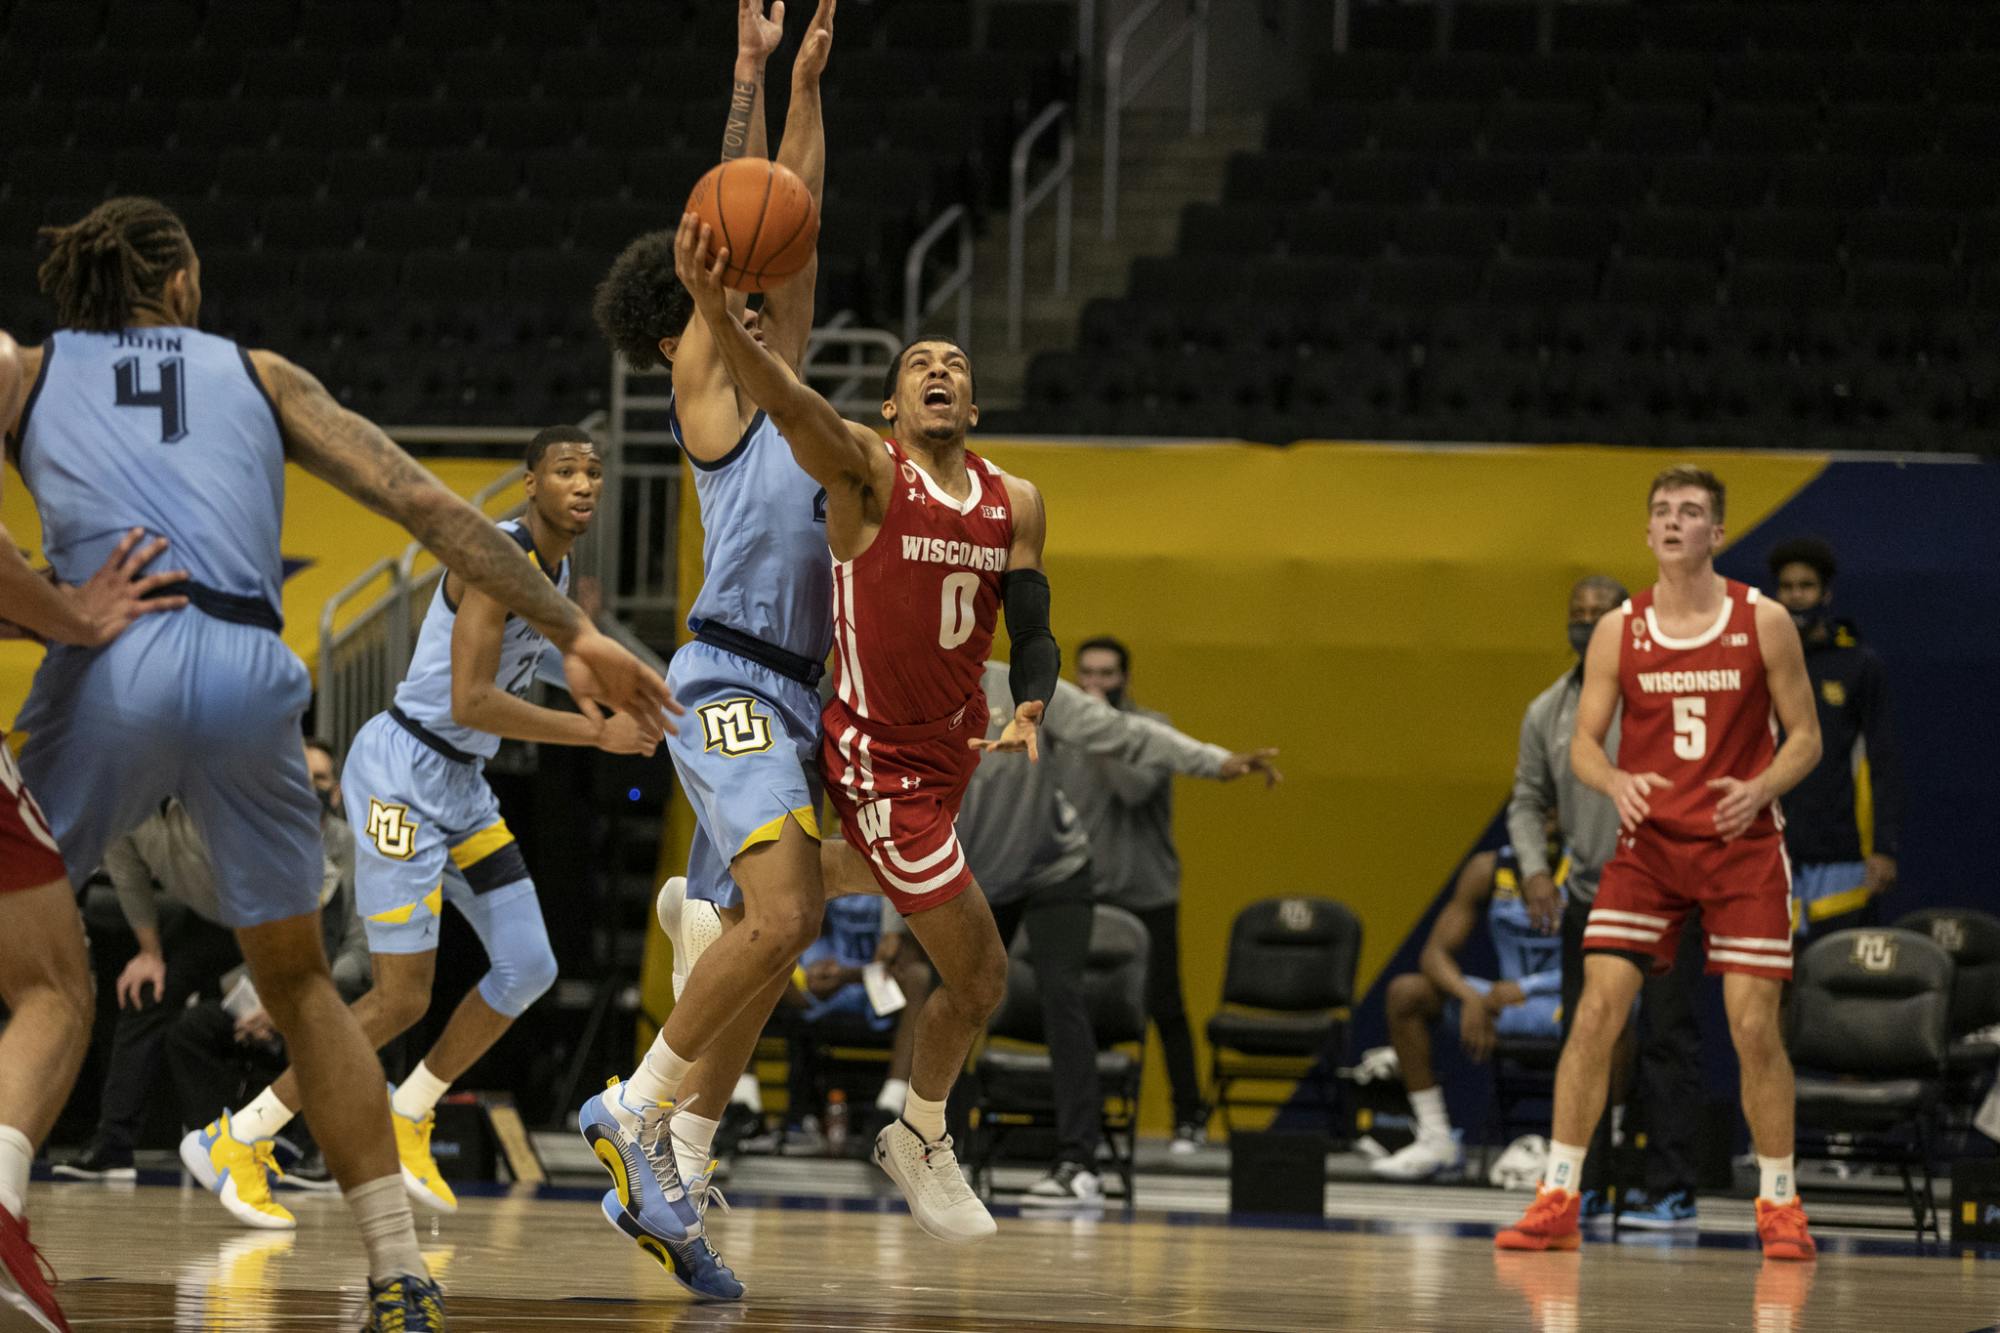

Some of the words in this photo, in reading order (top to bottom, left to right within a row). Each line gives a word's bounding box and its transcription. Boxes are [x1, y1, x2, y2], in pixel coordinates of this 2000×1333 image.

[733, 82, 755, 113] ME
[725, 120, 748, 147] ON
[112, 356, 190, 444] 4
[939, 572, 981, 650] 0
[1637, 669, 1742, 693] WISCONSIN
[696, 698, 774, 757] MU
[1672, 697, 1707, 760] 5
[366, 797, 417, 860] MU
[1852, 933, 1896, 973] MU
